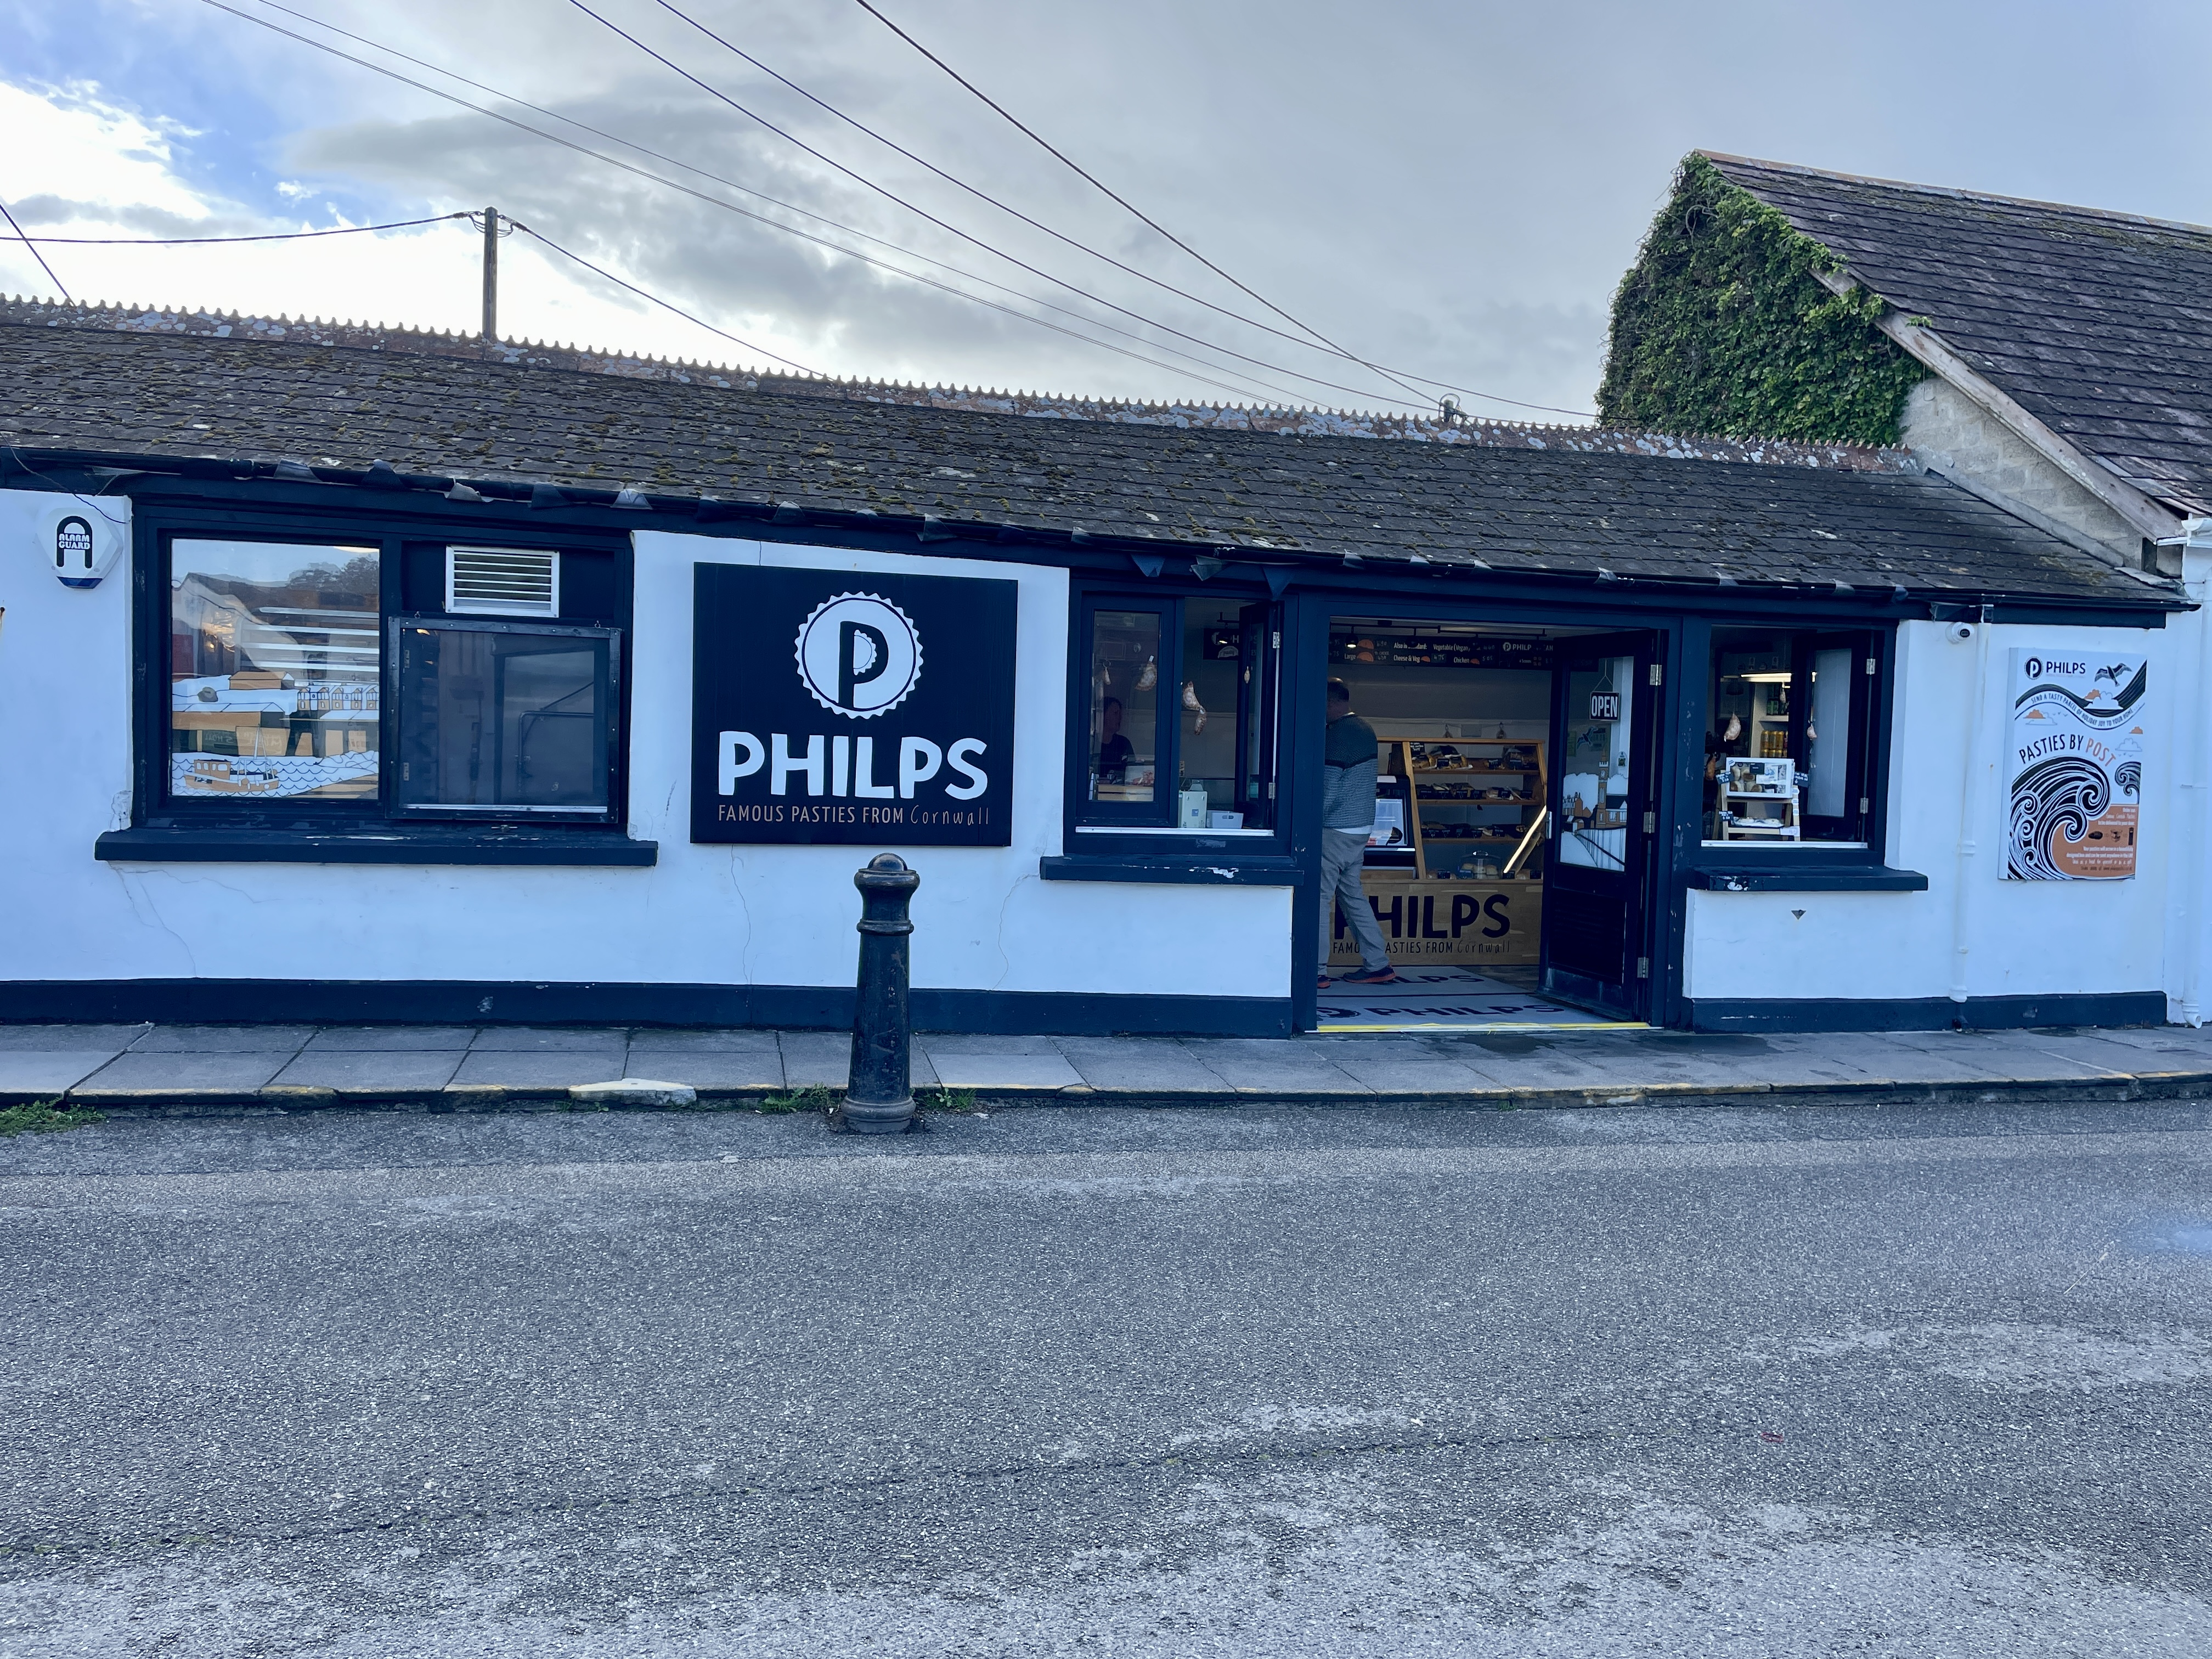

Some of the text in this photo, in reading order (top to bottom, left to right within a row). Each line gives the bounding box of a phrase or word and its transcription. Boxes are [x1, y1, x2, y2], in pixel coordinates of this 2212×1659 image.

[59, 533, 90, 542] ALARM
[58, 541, 91, 550] GUARD
[1344, 653, 1356, 661] Large
[1412, 655, 1420, 663] Veg
[2046, 661, 2086, 674] PHILPS
[1591, 695, 1618, 718] OPEN
[2031, 695, 2043, 704] SEND
[2049, 693, 2063, 702] TASTY
[2063, 697, 2077, 712] PARCEL
[2081, 713, 2098, 726] HOLIDAY
[2112, 716, 2123, 725] YOUR
[2018, 733, 2116, 767] PASTIES BY POST
[718, 730, 988, 800] PHILPS
[718, 804, 989, 826] FAMOUS PASTIES FROM Cornwall
[1333, 939, 1510, 955] FAMO ASTIES FROM Cornwall
[1364, 1004, 1565, 1016] PHILPS
